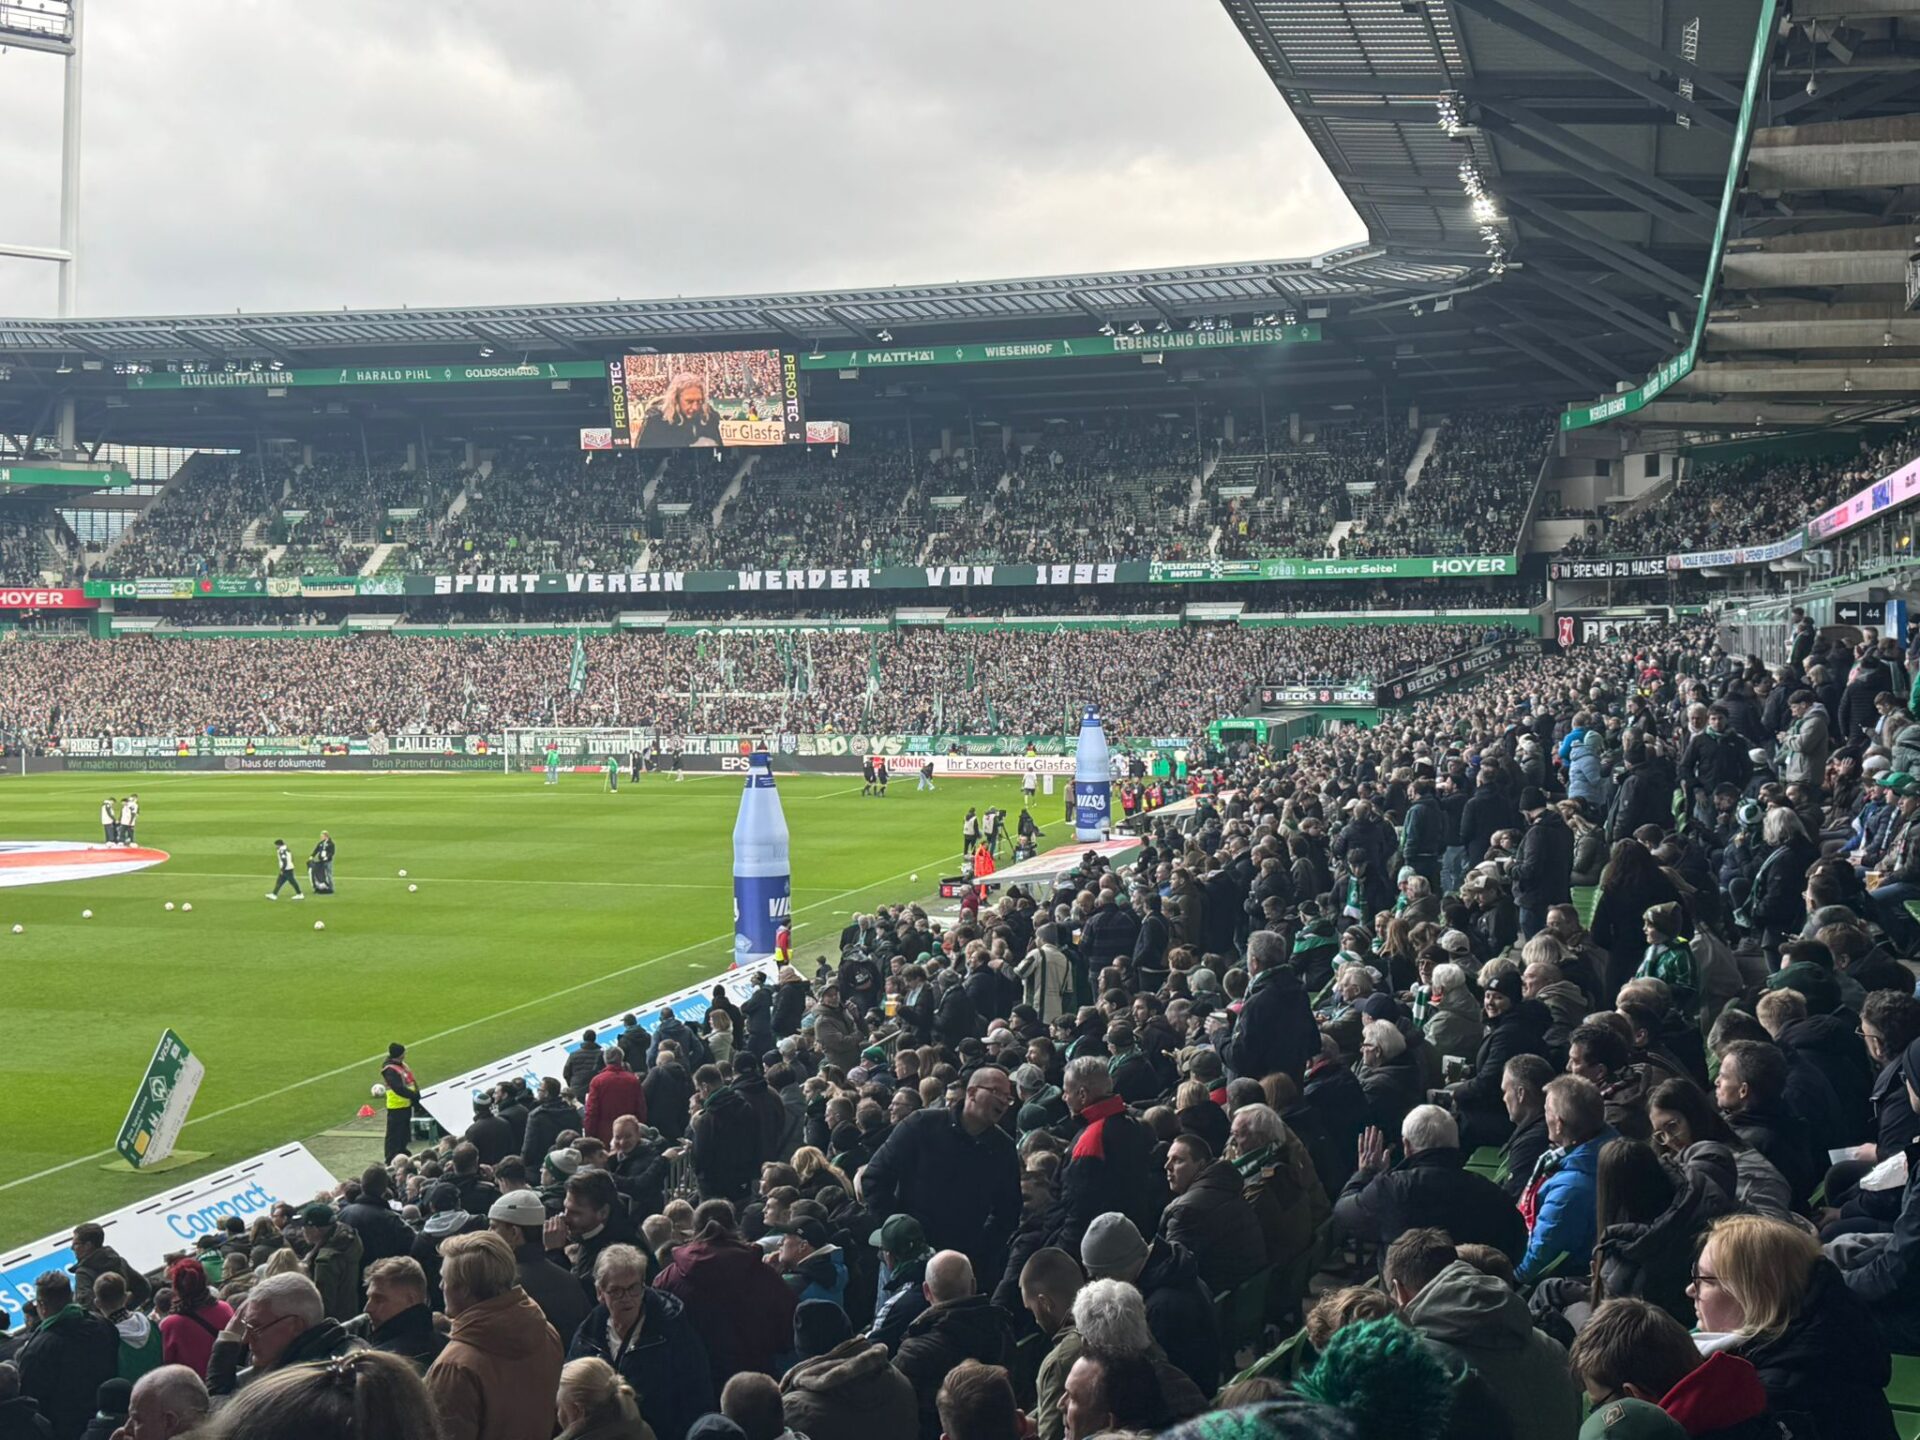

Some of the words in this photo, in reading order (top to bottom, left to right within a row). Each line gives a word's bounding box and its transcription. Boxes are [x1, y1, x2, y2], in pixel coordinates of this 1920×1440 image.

[1113, 333, 1194, 350] LEBENSLANG
[1198, 328, 1283, 345] GRÜN-WEISS
[867, 351, 935, 363] MATTHÄI
[985, 344, 1053, 357] WIESENHOF
[180, 371, 294, 386] FLUTLICHTPARTNER
[357, 371, 401, 381] HARALD
[405, 370, 432, 380] PIHL
[611, 361, 626, 429] PERSOTEC
[783, 354, 799, 422] PERSOTEC
[721, 424, 740, 439] für
[1307, 566, 1324, 575] an
[1325, 564, 1359, 575] Eurer
[1361, 564, 1397, 573] Seite!
[1432, 558, 1506, 573] HOYER
[1573, 562, 1613, 577] BREMEN
[1615, 562, 1629, 576] ZU
[1631, 560, 1665, 575] HAUSE
[434, 574, 540, 595] SPORT
[566, 571, 685, 593] VEREIN
[926, 566, 994, 587] VON
[1036, 563, 1117, 585] 1899
[1866, 608, 1880, 618] 44
[1407, 668, 1447, 692] BECK'S
[1462, 650, 1502, 672] BECK'S
[1275, 691, 1317, 701] BECK'S
[1333, 690, 1375, 701] BECK'S
[395, 737, 453, 751] CAILLERA
[711, 740, 739, 754] ULTRA
[67, 758, 83, 769] Wir
[83, 759, 118, 769] machen
[120, 758, 147, 771] richtig
[150, 758, 176, 769] Druck!
[241, 758, 262, 768] haus
[263, 758, 277, 768] der
[278, 758, 326, 768] dokumente
[372, 758, 393, 768] Dein
[395, 758, 428, 768] Partner
[430, 758, 443, 768] für
[890, 756, 926, 768] KÖNIG
[946, 758, 963, 769] Ihr
[965, 758, 1013, 772] Experte
[1014, 758, 1031, 770] für
[1076, 794, 1106, 811] VILSA
[157, 1037, 173, 1062] VISA
[167, 1181, 277, 1240] Compact
